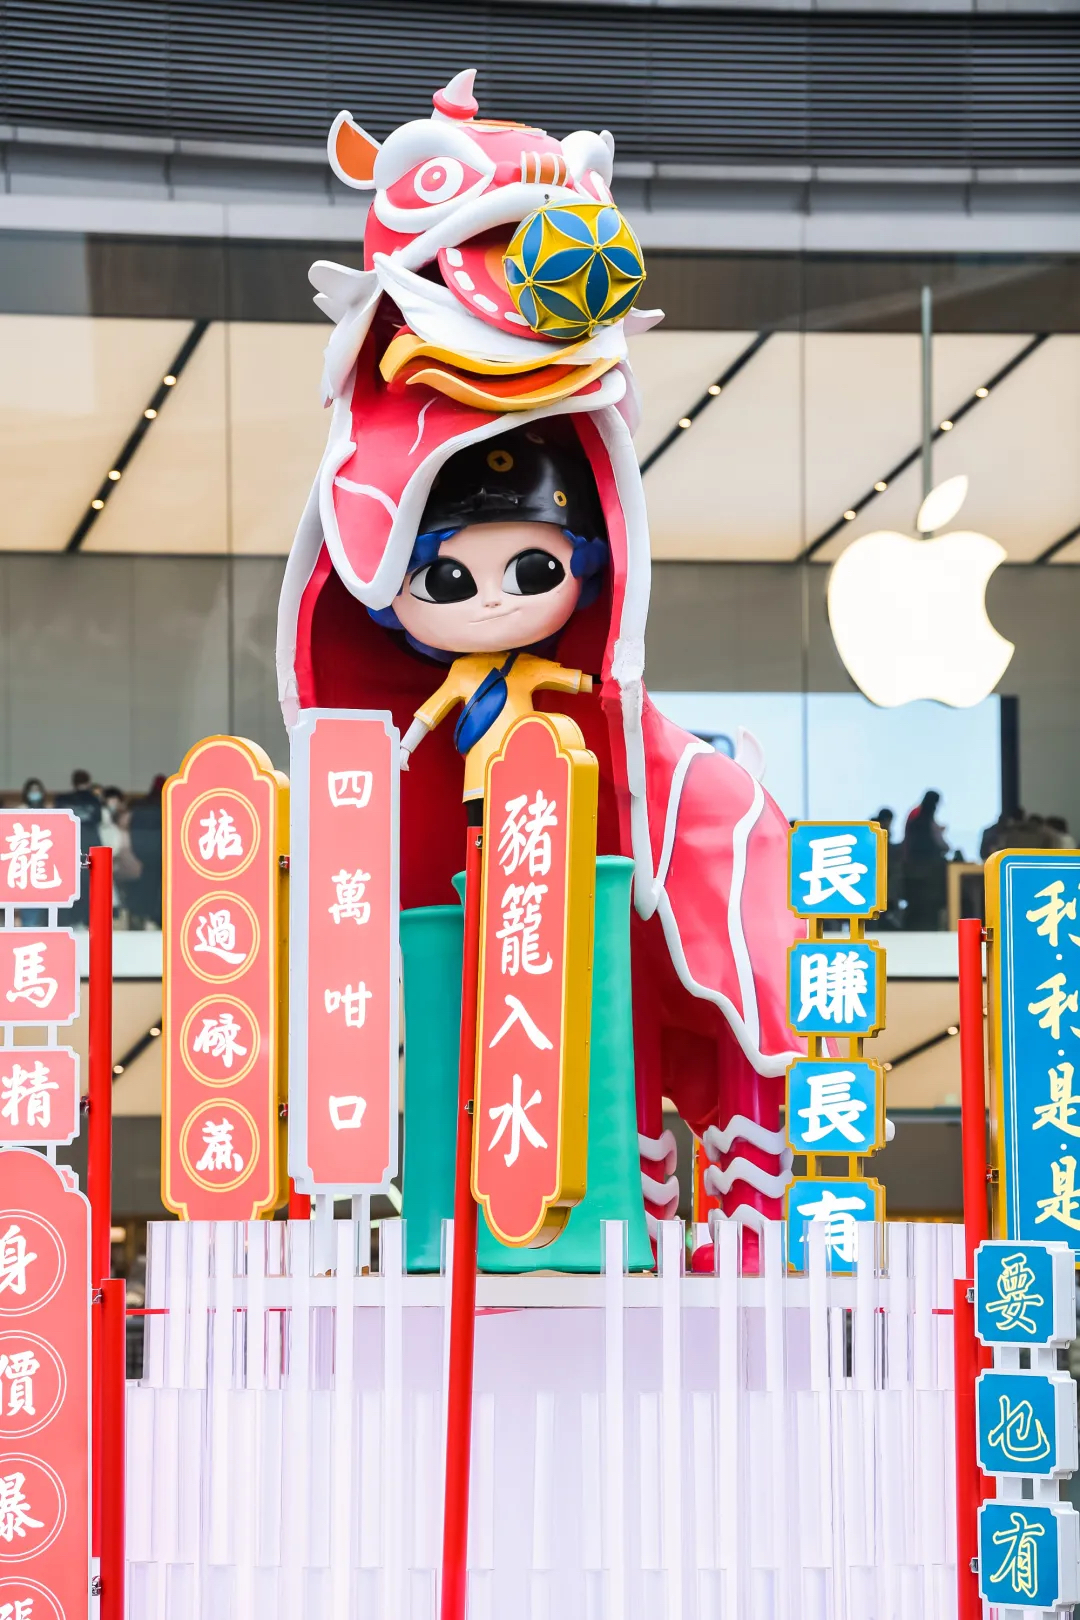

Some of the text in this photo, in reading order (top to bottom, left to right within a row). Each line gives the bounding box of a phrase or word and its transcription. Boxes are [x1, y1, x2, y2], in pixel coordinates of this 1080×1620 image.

[0, 823, 62, 1128] 龍馬精
[193, 809, 247, 1172] 掂過碌蔗
[324, 770, 373, 1131] 四萬咁口
[489, 790, 557, 1168] 豬籠入水
[797, 834, 868, 1262] 長賺長有
[985, 1252, 1051, 1598] 要乜有
